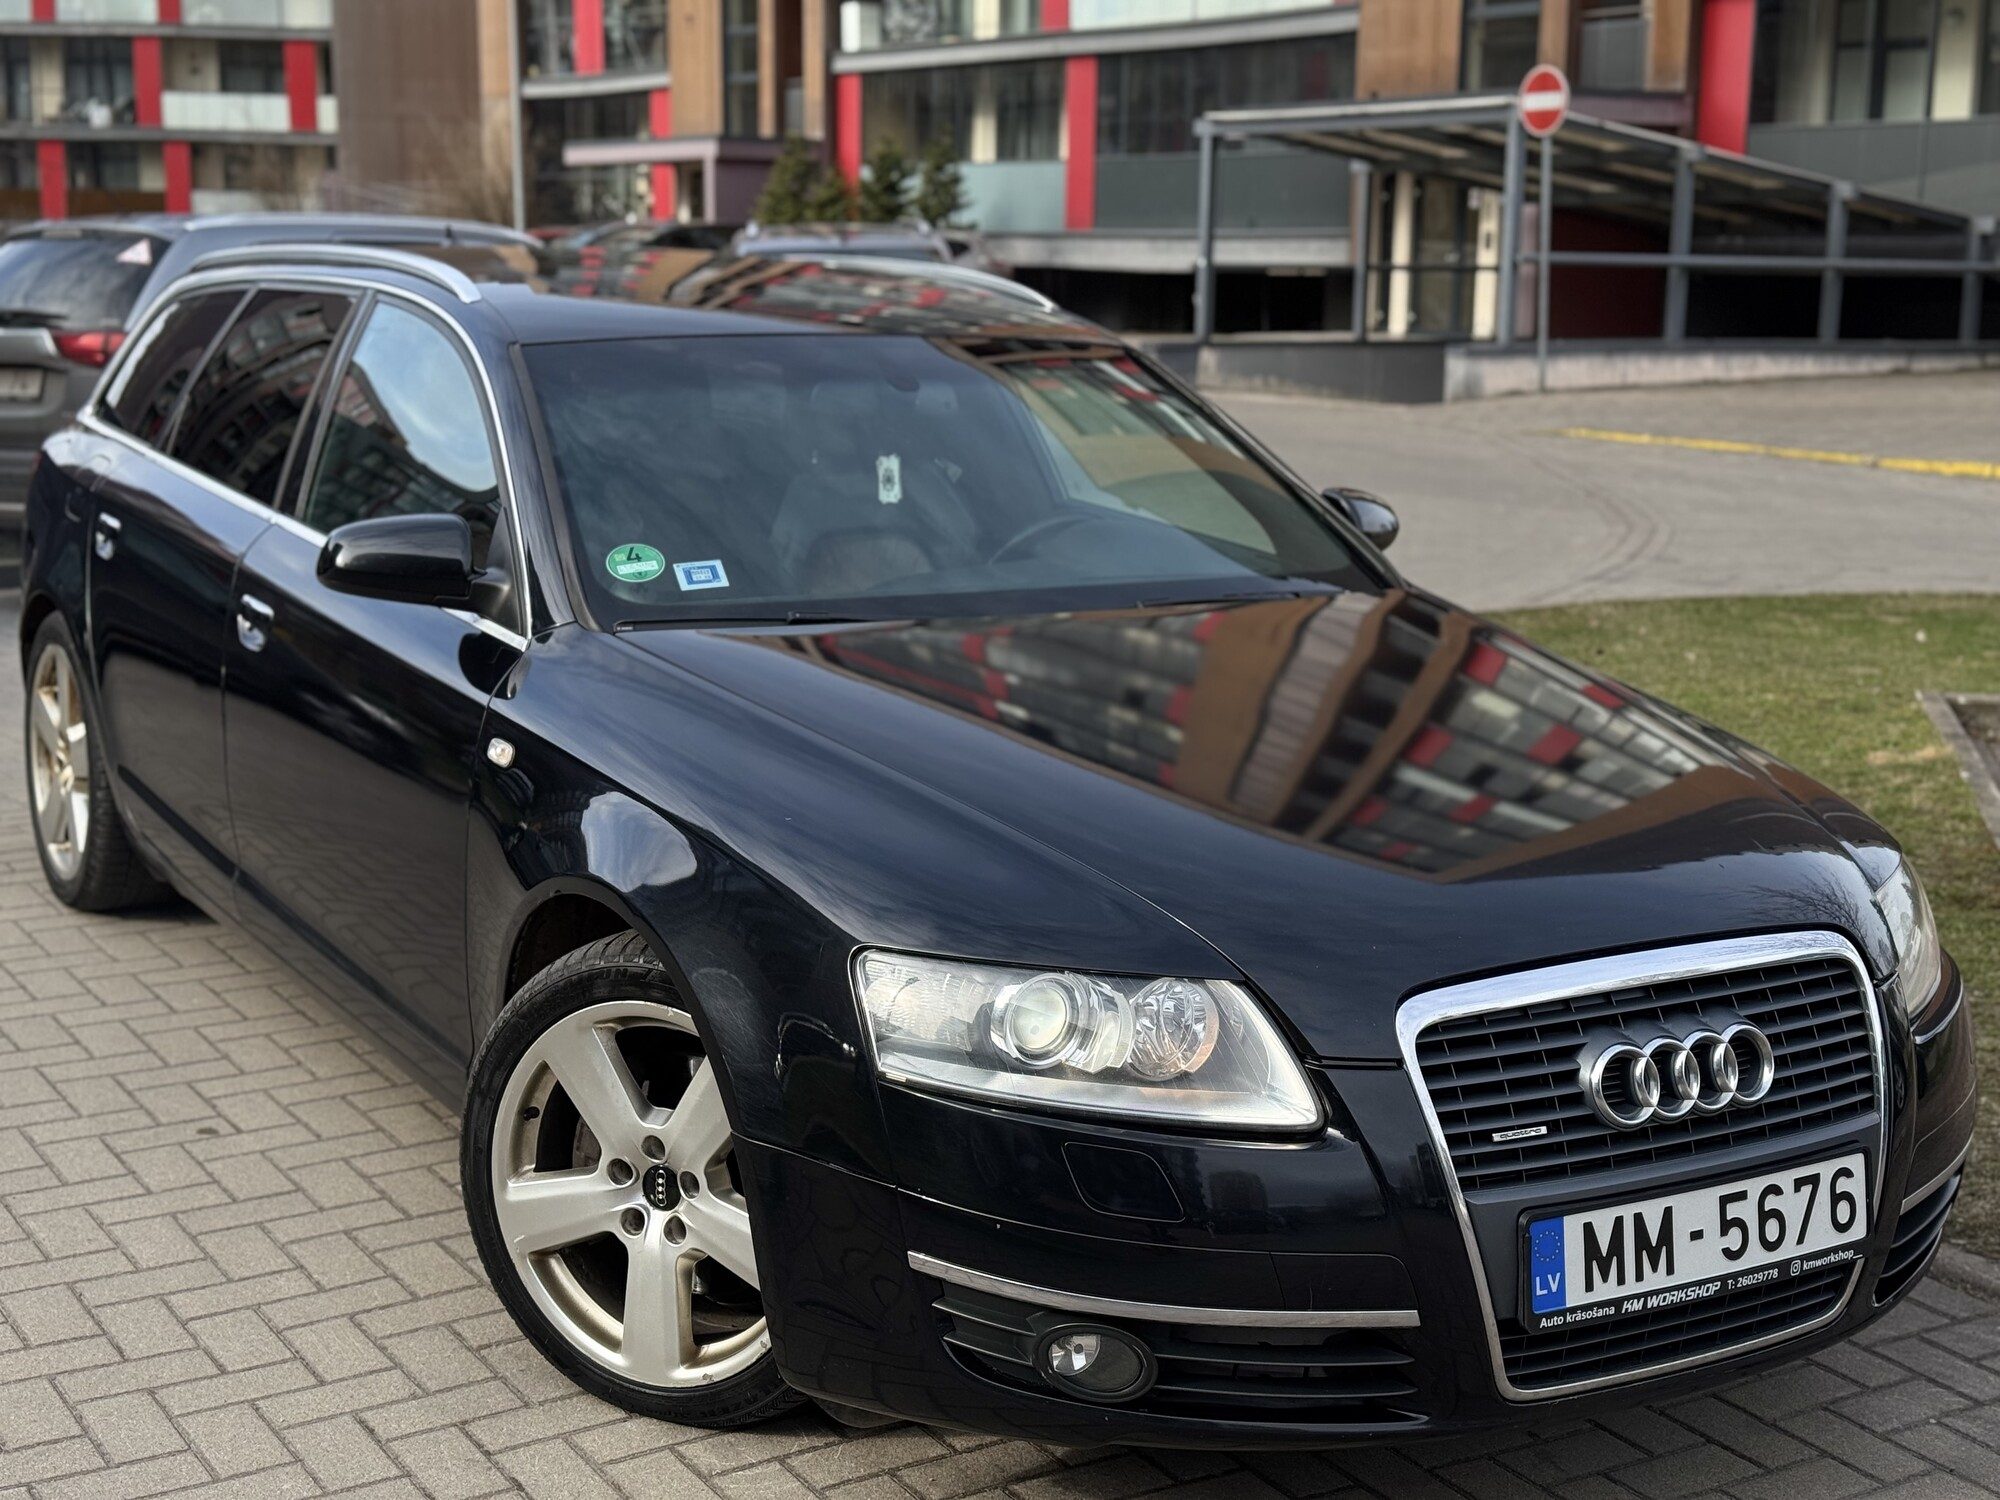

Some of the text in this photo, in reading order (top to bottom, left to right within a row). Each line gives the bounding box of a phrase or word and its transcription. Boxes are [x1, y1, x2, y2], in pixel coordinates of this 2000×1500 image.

[626, 546, 642, 562] 4
[1499, 1128, 1542, 1140] quattro
[1536, 1272, 1561, 1296] LV
[1540, 1314, 1564, 1329] Auto
[1566, 1305, 1615, 1323] krāsošana
[1621, 1299, 1645, 1314] KM
[1647, 1281, 1721, 1309] WORKSHOP
[1727, 1279, 1736, 1290] T:
[1736, 1268, 1779, 1288] 26029778
